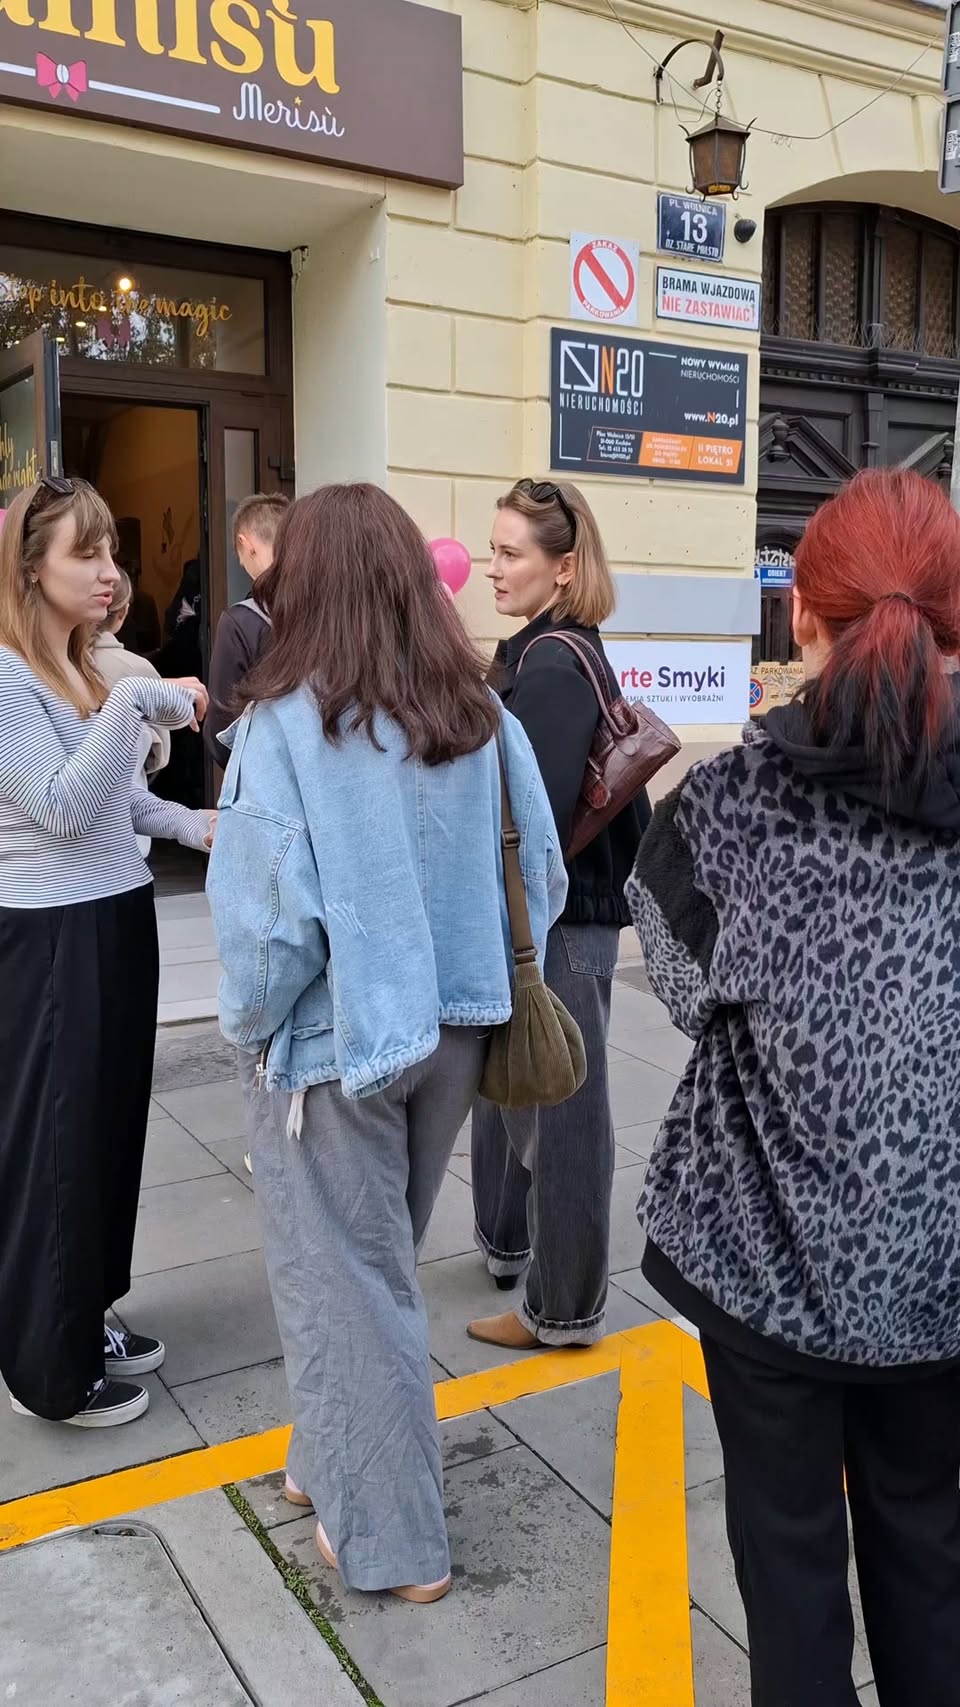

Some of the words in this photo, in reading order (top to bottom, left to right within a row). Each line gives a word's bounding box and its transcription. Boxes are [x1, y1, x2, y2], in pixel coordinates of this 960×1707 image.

[232, 81, 345, 138] Merisù
[683, 200, 718, 217] WOLNICA
[680, 210, 708, 244] 13
[591, 240, 618, 252] ZAKAZ
[676, 240, 695, 253] STARE
[696, 243, 719, 258] MIASTO
[662, 275, 698, 295] BRAMA
[701, 280, 756, 303] WJAZDOWA
[50, 276, 106, 313] into
[155, 296, 233, 337] magic
[582, 299, 626, 318] PARKOWANIA
[661, 294, 682, 313] NIE
[601, 344, 644, 398] N20
[680, 356, 706, 369] NOWY
[707, 359, 740, 373] WYMIAR
[680, 368, 740, 384] NIERUCHOMOŚCI
[559, 391, 643, 417] NIERUCHOMOŚCI
[683, 410, 739, 428] www.N20.pl
[705, 444, 733, 456] PIĘTRO
[698, 455, 723, 466] LOKAL
[657, 665, 725, 693] Smyki
[646, 694, 673, 703] SZTUKI
